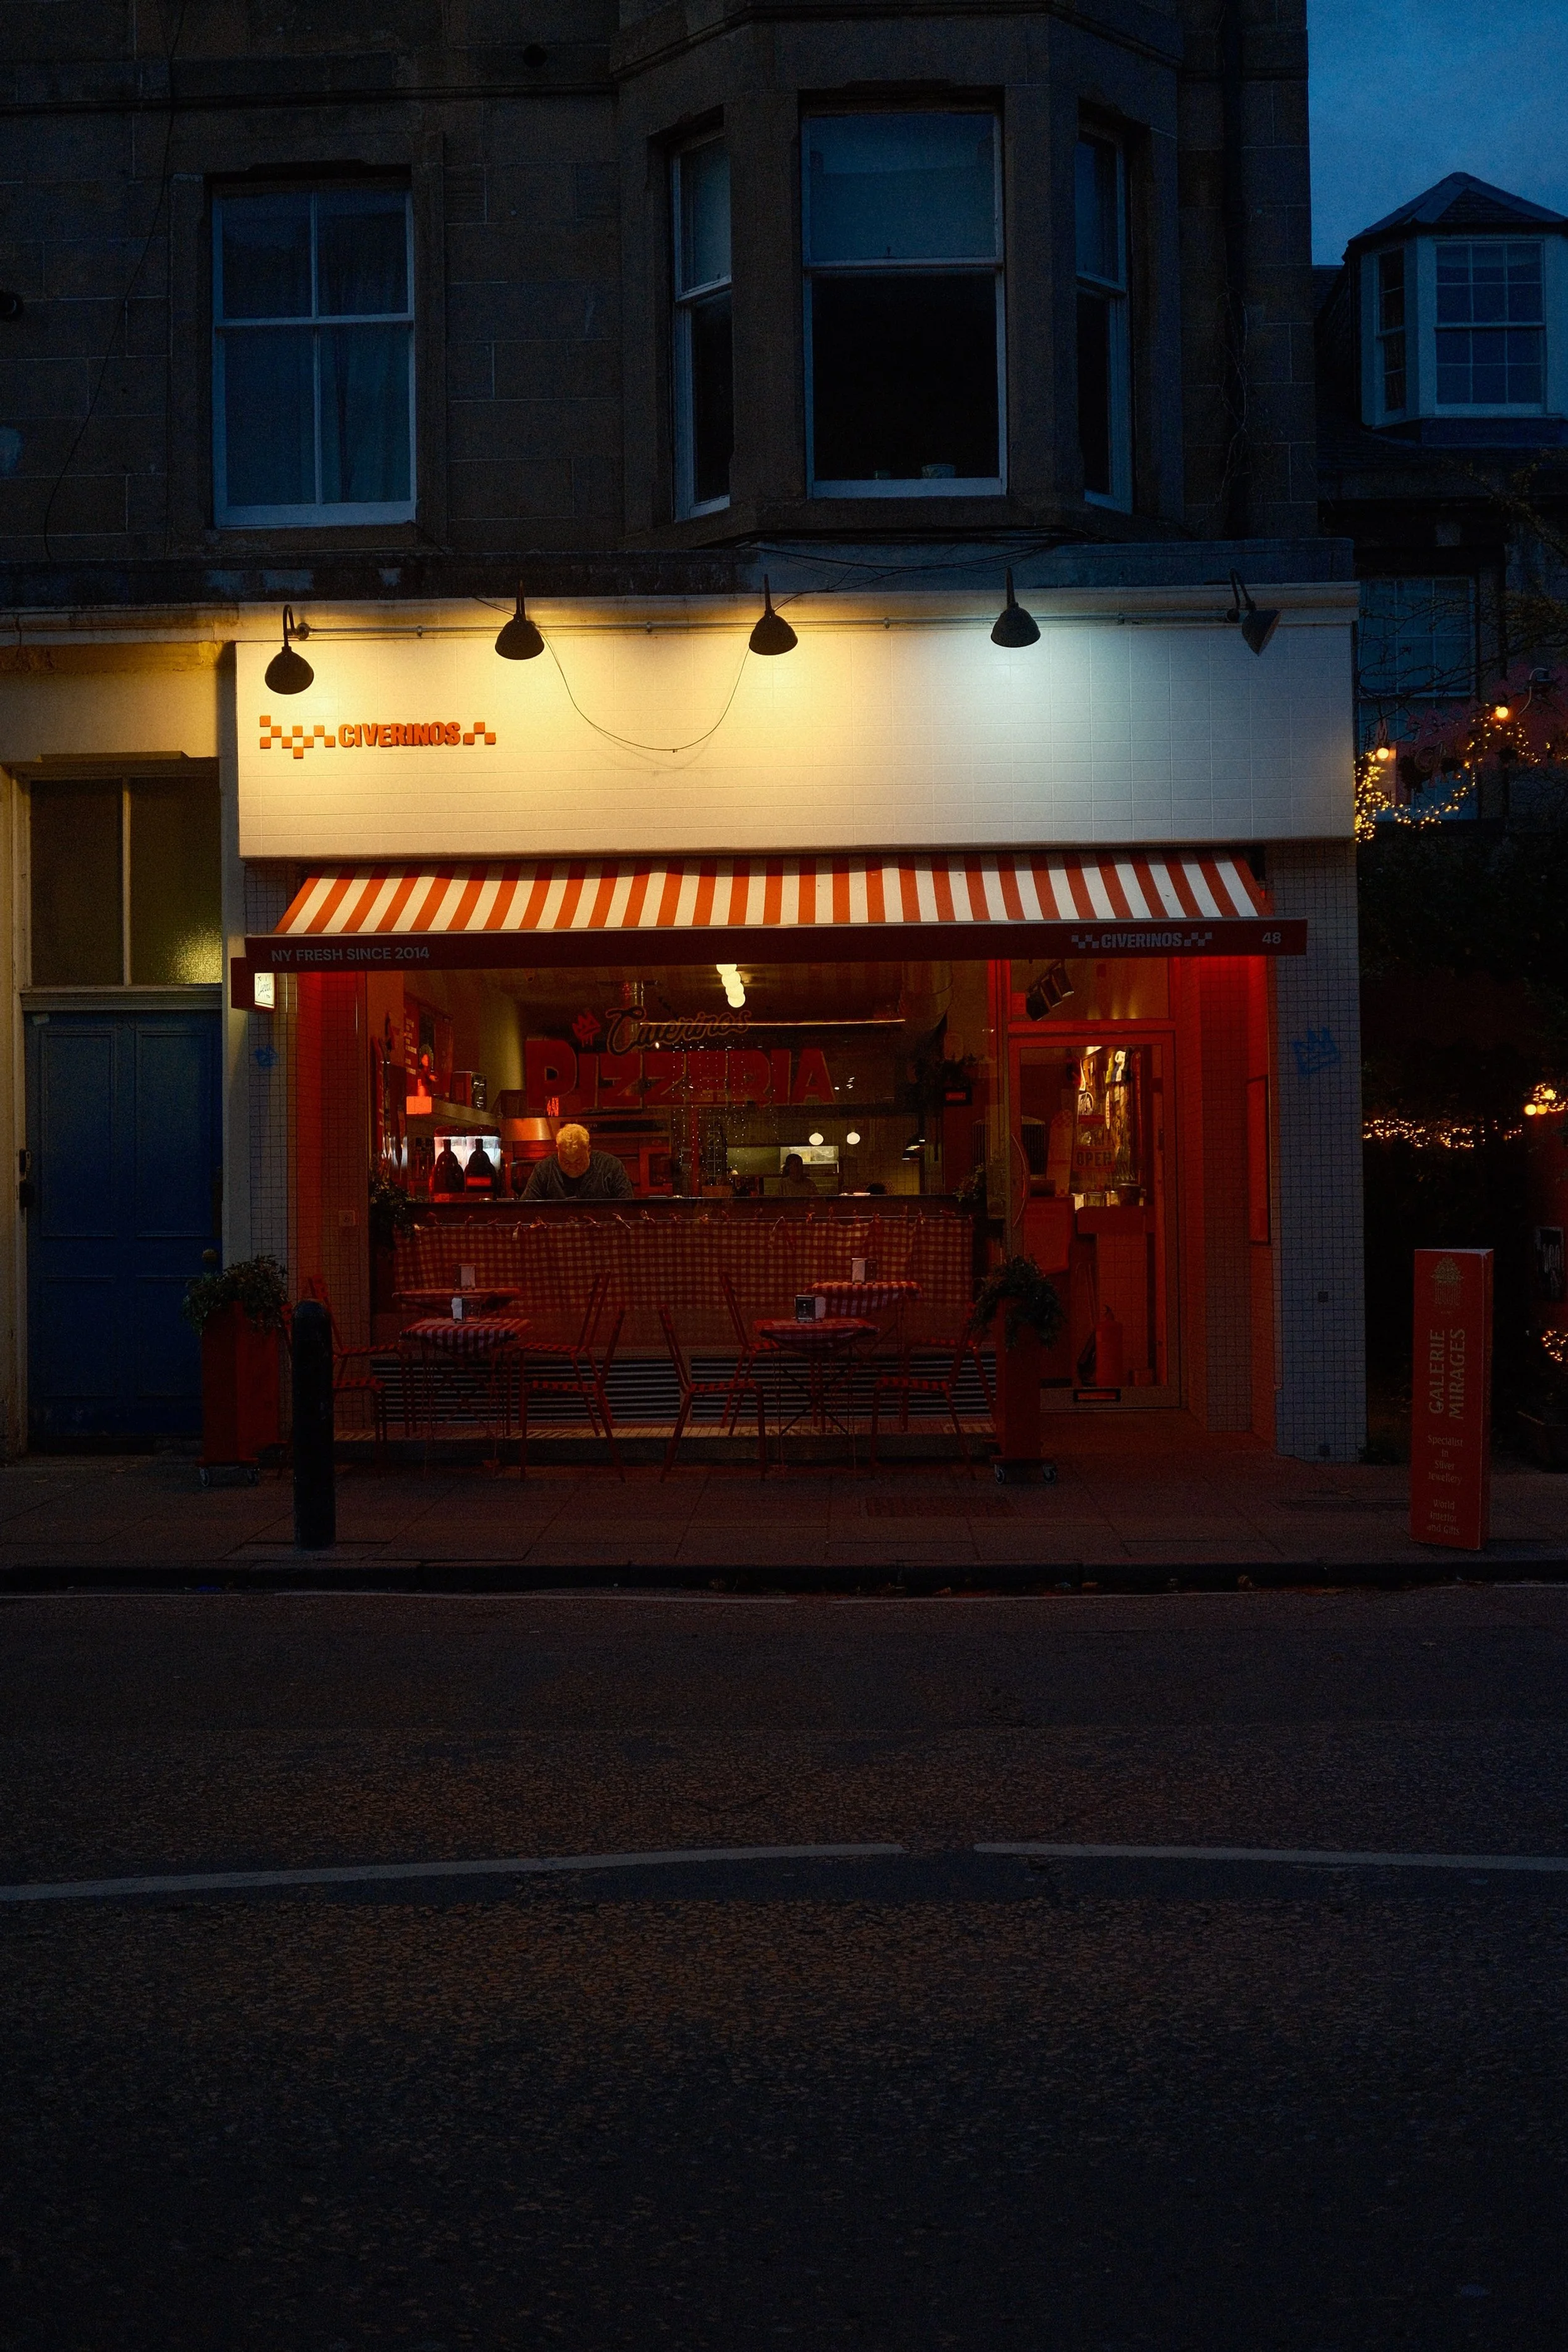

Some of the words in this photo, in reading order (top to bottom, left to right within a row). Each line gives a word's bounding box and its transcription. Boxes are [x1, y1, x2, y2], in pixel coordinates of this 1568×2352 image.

[338, 722, 461, 748] CIVERINOS
[1101, 933, 1183, 948] CIVERINOS
[1262, 932, 1282, 944] 48
[271, 949, 292, 961] NY
[296, 949, 343, 961] FRESH
[346, 948, 392, 960] SINCE
[395, 946, 430, 959] 2014
[1429, 1329, 1445, 1414] GALERIE
[1449, 1328, 1466, 1421] MIRAGES
